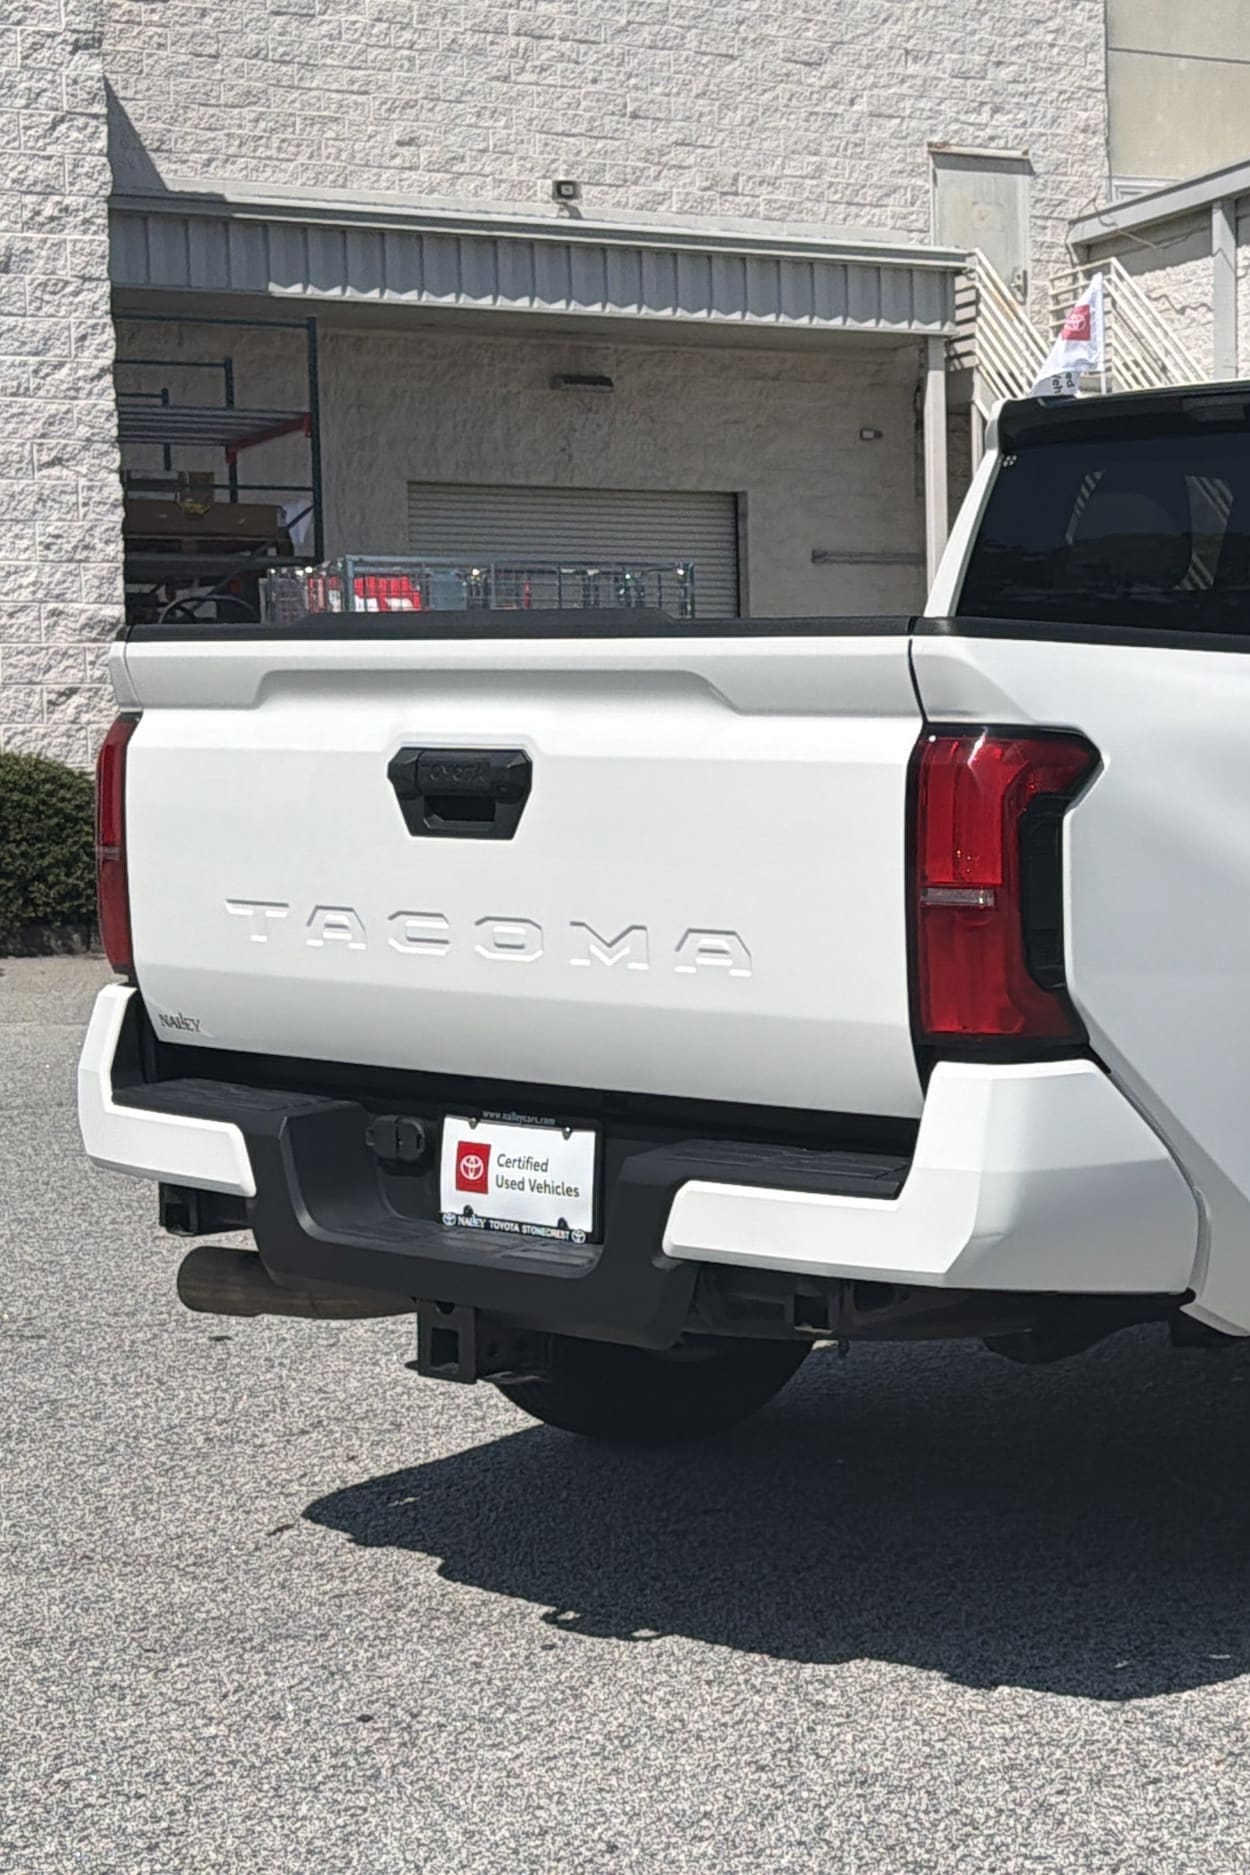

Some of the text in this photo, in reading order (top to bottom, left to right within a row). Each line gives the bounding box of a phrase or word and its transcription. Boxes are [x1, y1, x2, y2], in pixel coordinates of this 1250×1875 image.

[225, 898, 753, 977] TACOMA
[497, 1153, 549, 1173] Certified
[495, 1174, 580, 1198] Used Vehicles
[489, 1220, 520, 1233] TOYOTA
[521, 1224, 570, 1240] STONECREST
